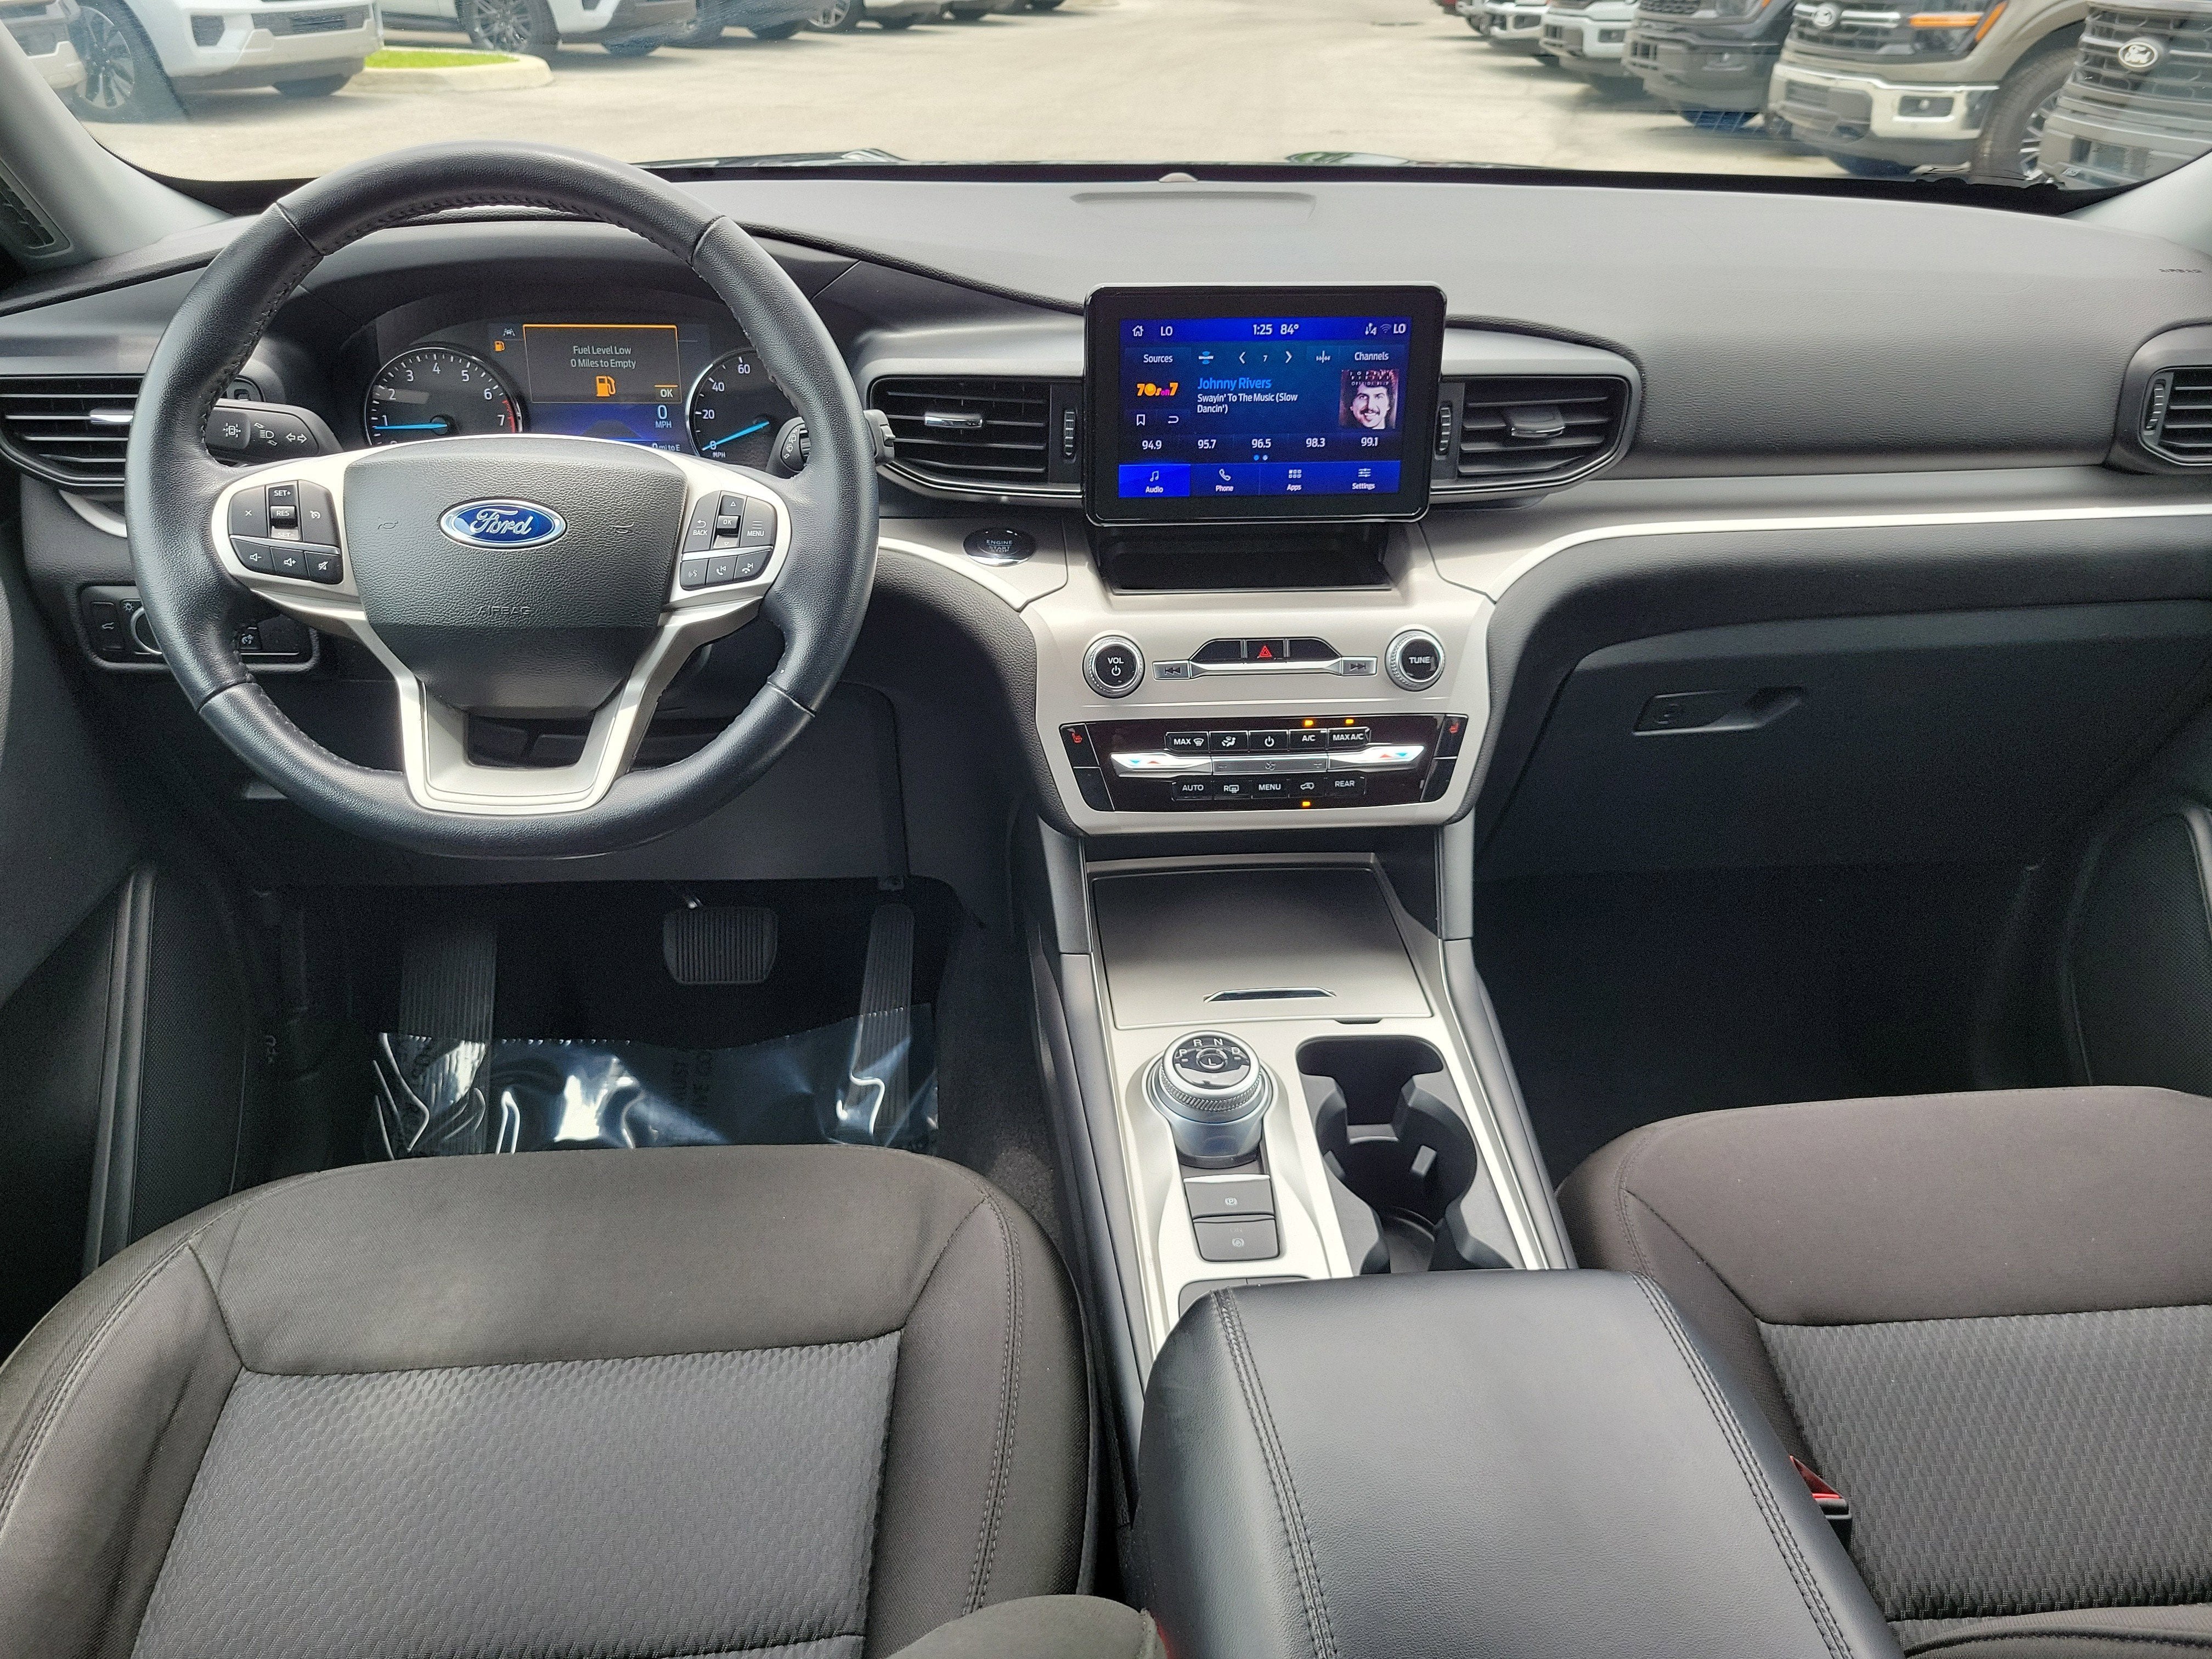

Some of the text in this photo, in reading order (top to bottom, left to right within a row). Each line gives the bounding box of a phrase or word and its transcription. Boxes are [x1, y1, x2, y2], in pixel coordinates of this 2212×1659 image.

[1160, 326, 1173, 336] LO
[1252, 324, 1299, 335] 1:25 84°
[1393, 323, 1407, 334] LO
[573, 346, 631, 354] Fuel Level Low
[1143, 354, 1173, 363] Sources
[1354, 351, 1389, 361] Channels
[433, 362, 441, 374] 4
[571, 359, 636, 369] 0 Miles to Empty
[737, 364, 751, 374] 60
[405, 369, 414, 382] 3
[461, 370, 470, 382] 5
[712, 381, 725, 392] 40
[1198, 377, 1272, 391] Johnny Rivers
[388, 388, 396, 400] 2
[483, 388, 493, 400] 6
[660, 388, 674, 398] OK
[1197, 392, 1299, 403] Swayin' To The Music (Slow
[657, 404, 668, 420] 0
[702, 409, 715, 419] 20
[1197, 404, 1228, 414] Dancin')
[382, 414, 388, 426] 1
[497, 414, 505, 426] 7
[655, 420, 672, 428] MPH
[1142, 439, 1162, 450] 94.9
[1198, 439, 1217, 449] 95.7
[1251, 438, 1272, 448] 96.5
[1306, 437, 1326, 447] 98.3
[1361, 437, 1379, 447] 99.1
[470, 508, 534, 535] Ford
[1193, 1039, 1203, 1047] R
[1178, 1048, 1188, 1057] P
